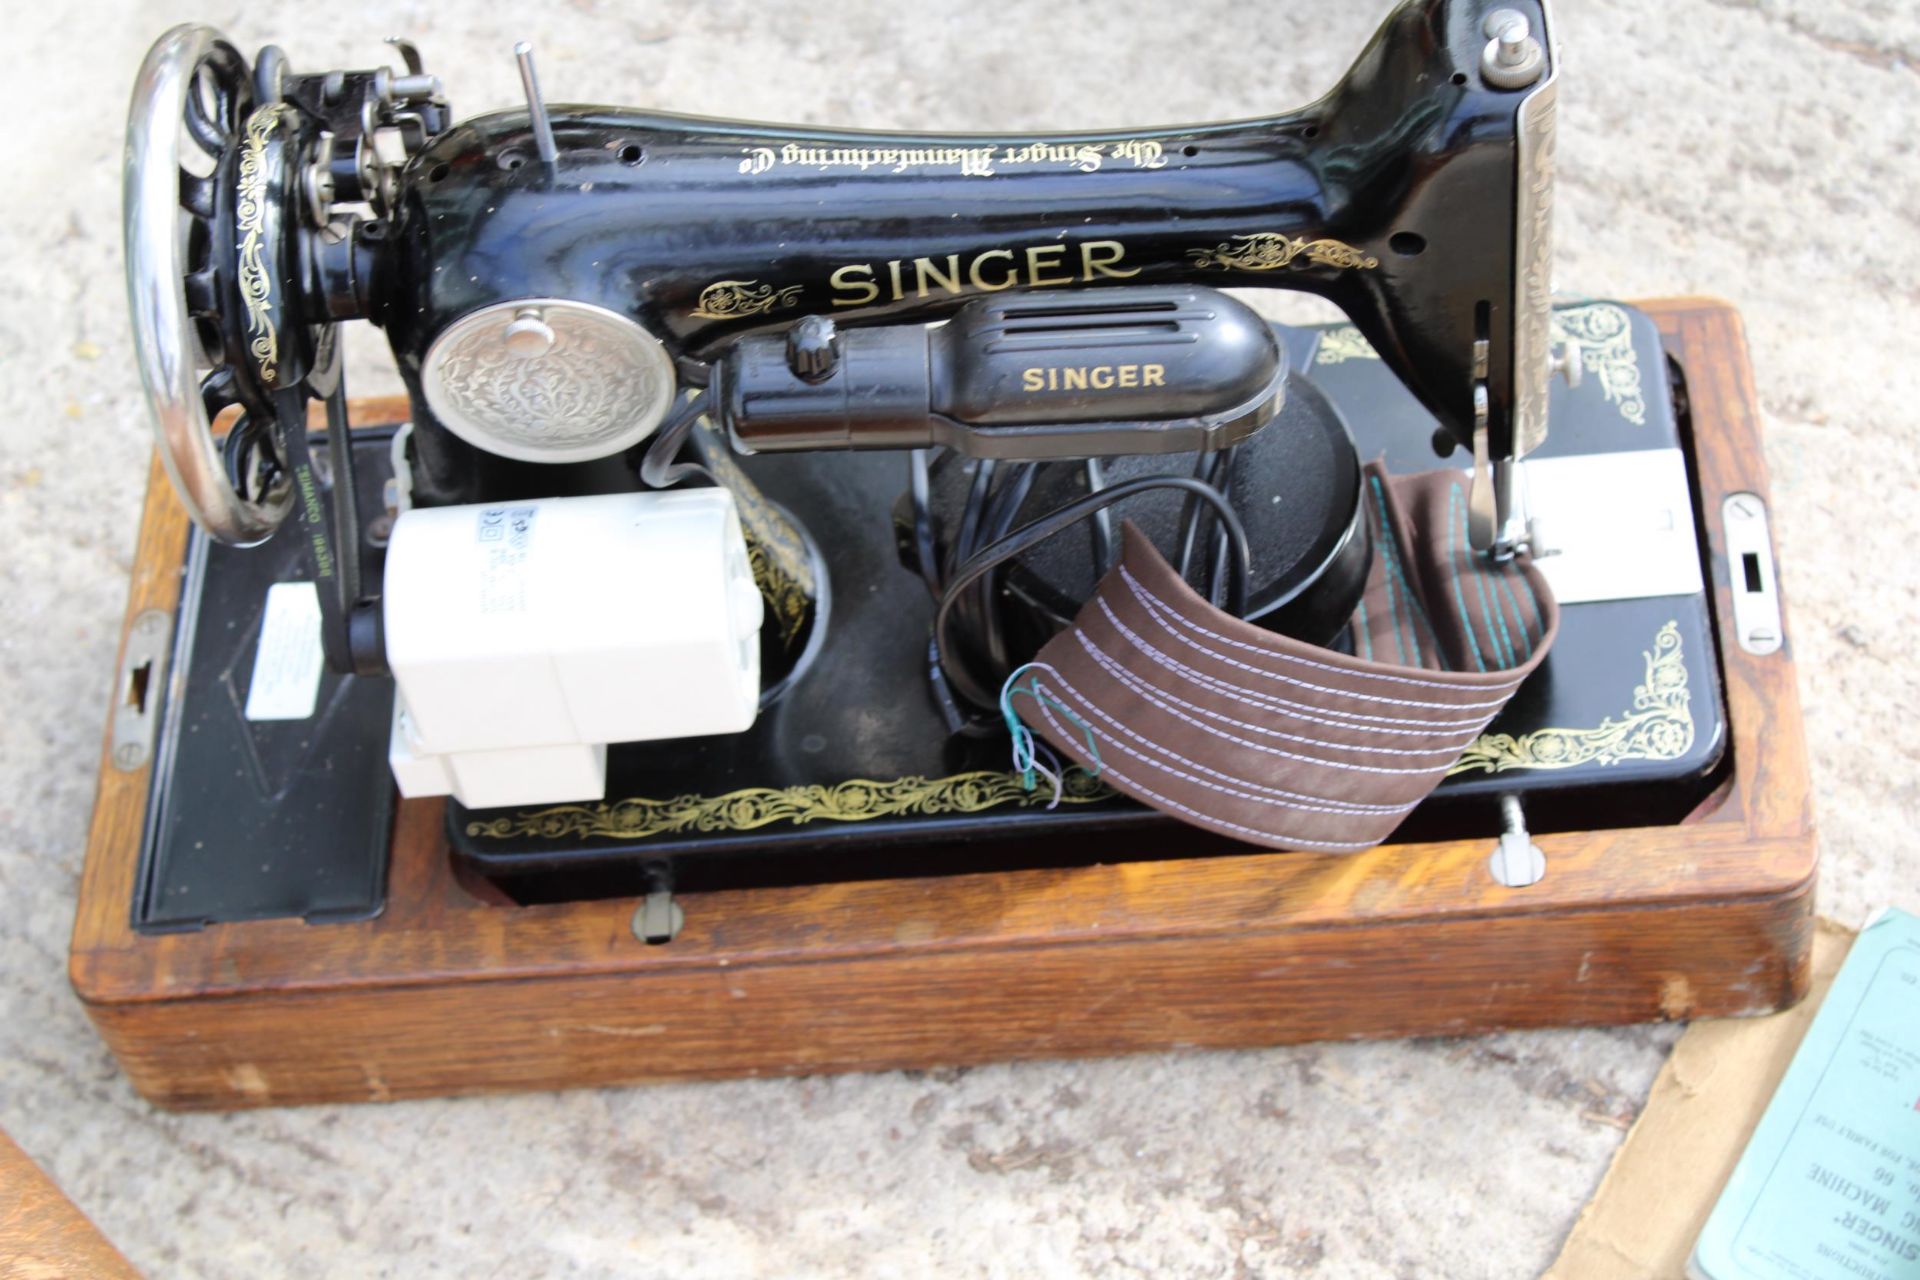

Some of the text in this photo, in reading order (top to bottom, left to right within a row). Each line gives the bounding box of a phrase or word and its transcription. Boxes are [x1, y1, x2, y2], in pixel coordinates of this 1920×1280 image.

[781, 143, 998, 178] Manufacturing
[1000, 142, 1107, 173] Singer
[1111, 141, 1168, 169] The
[829, 240, 1142, 306] SINGER
[1023, 363, 1166, 392] SINGER
[1804, 1162, 1891, 1216] MACHINE
